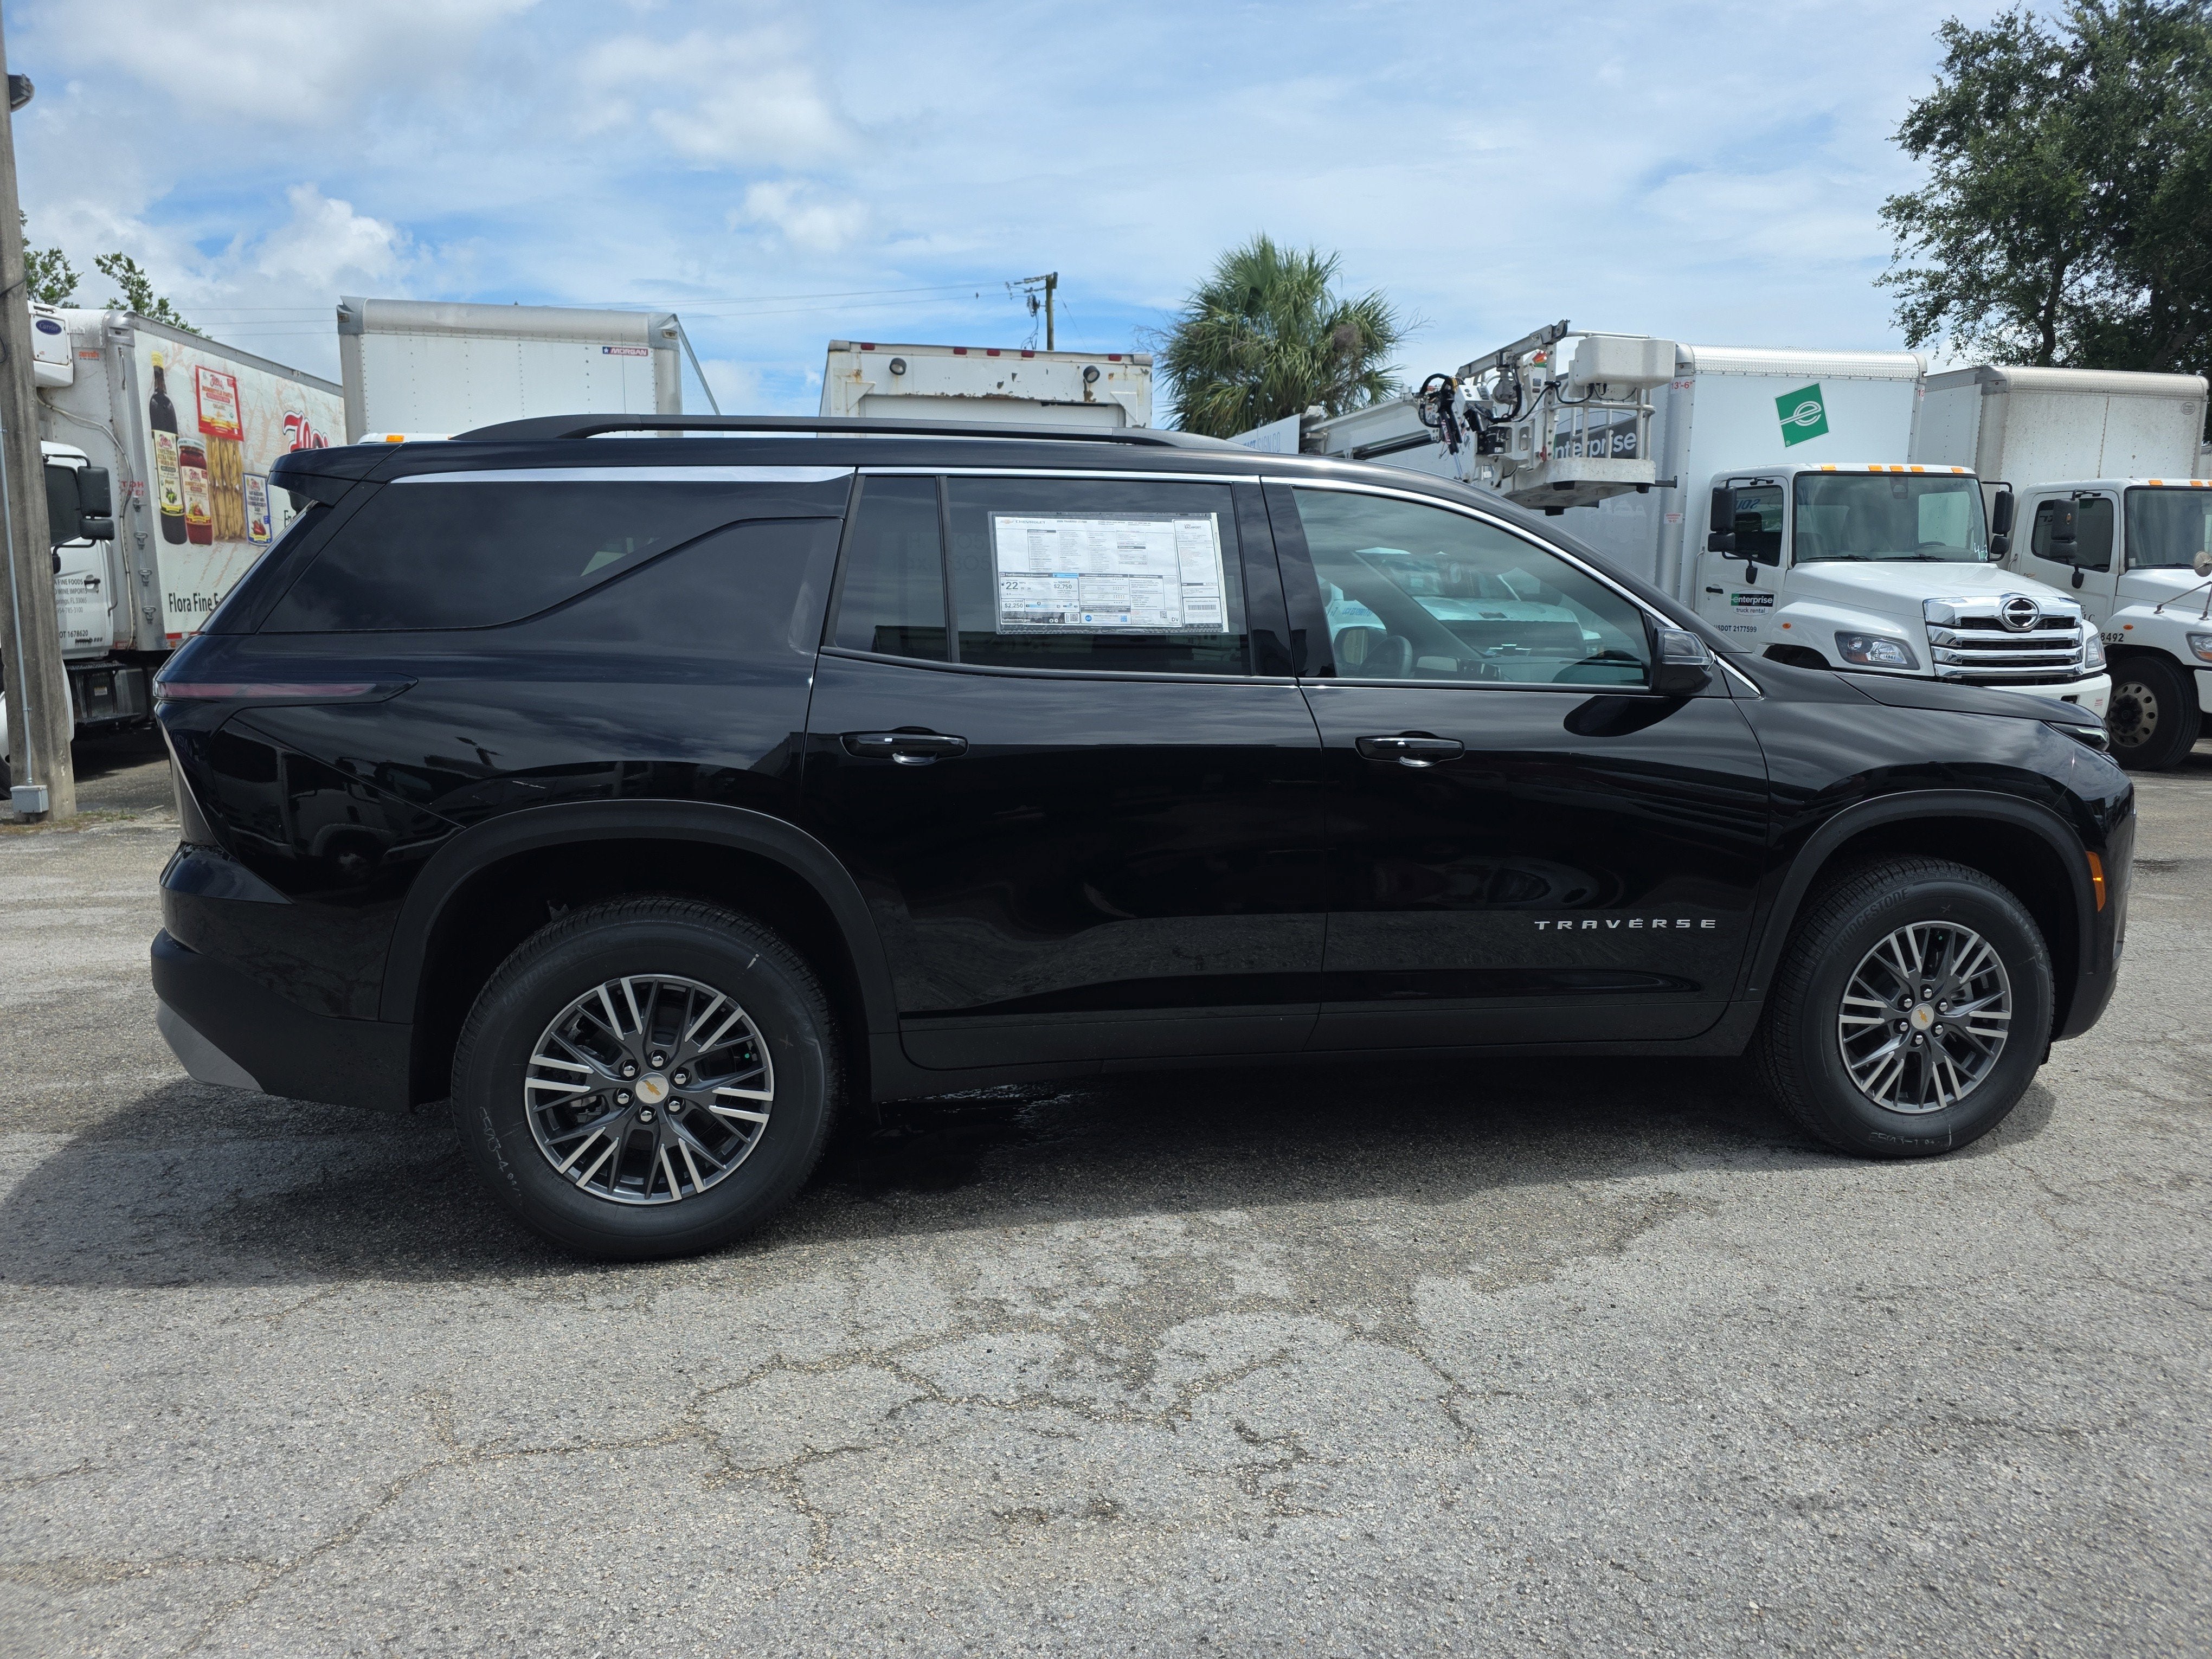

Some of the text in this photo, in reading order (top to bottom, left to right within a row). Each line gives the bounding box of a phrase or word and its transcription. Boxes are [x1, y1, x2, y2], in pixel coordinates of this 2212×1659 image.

[39, 322, 59, 331] Carrier
[610, 348, 647, 356] MORGAN
[1006, 582, 1019, 590] 22
[169, 592, 192, 613] Flora
[193, 592, 213, 612] Fine
[1733, 596, 1773, 605] enterprise
[68, 629, 88, 638] 1678620
[2100, 632, 2124, 642] 8492
[1534, 918, 1716, 930] TRAVERSE
